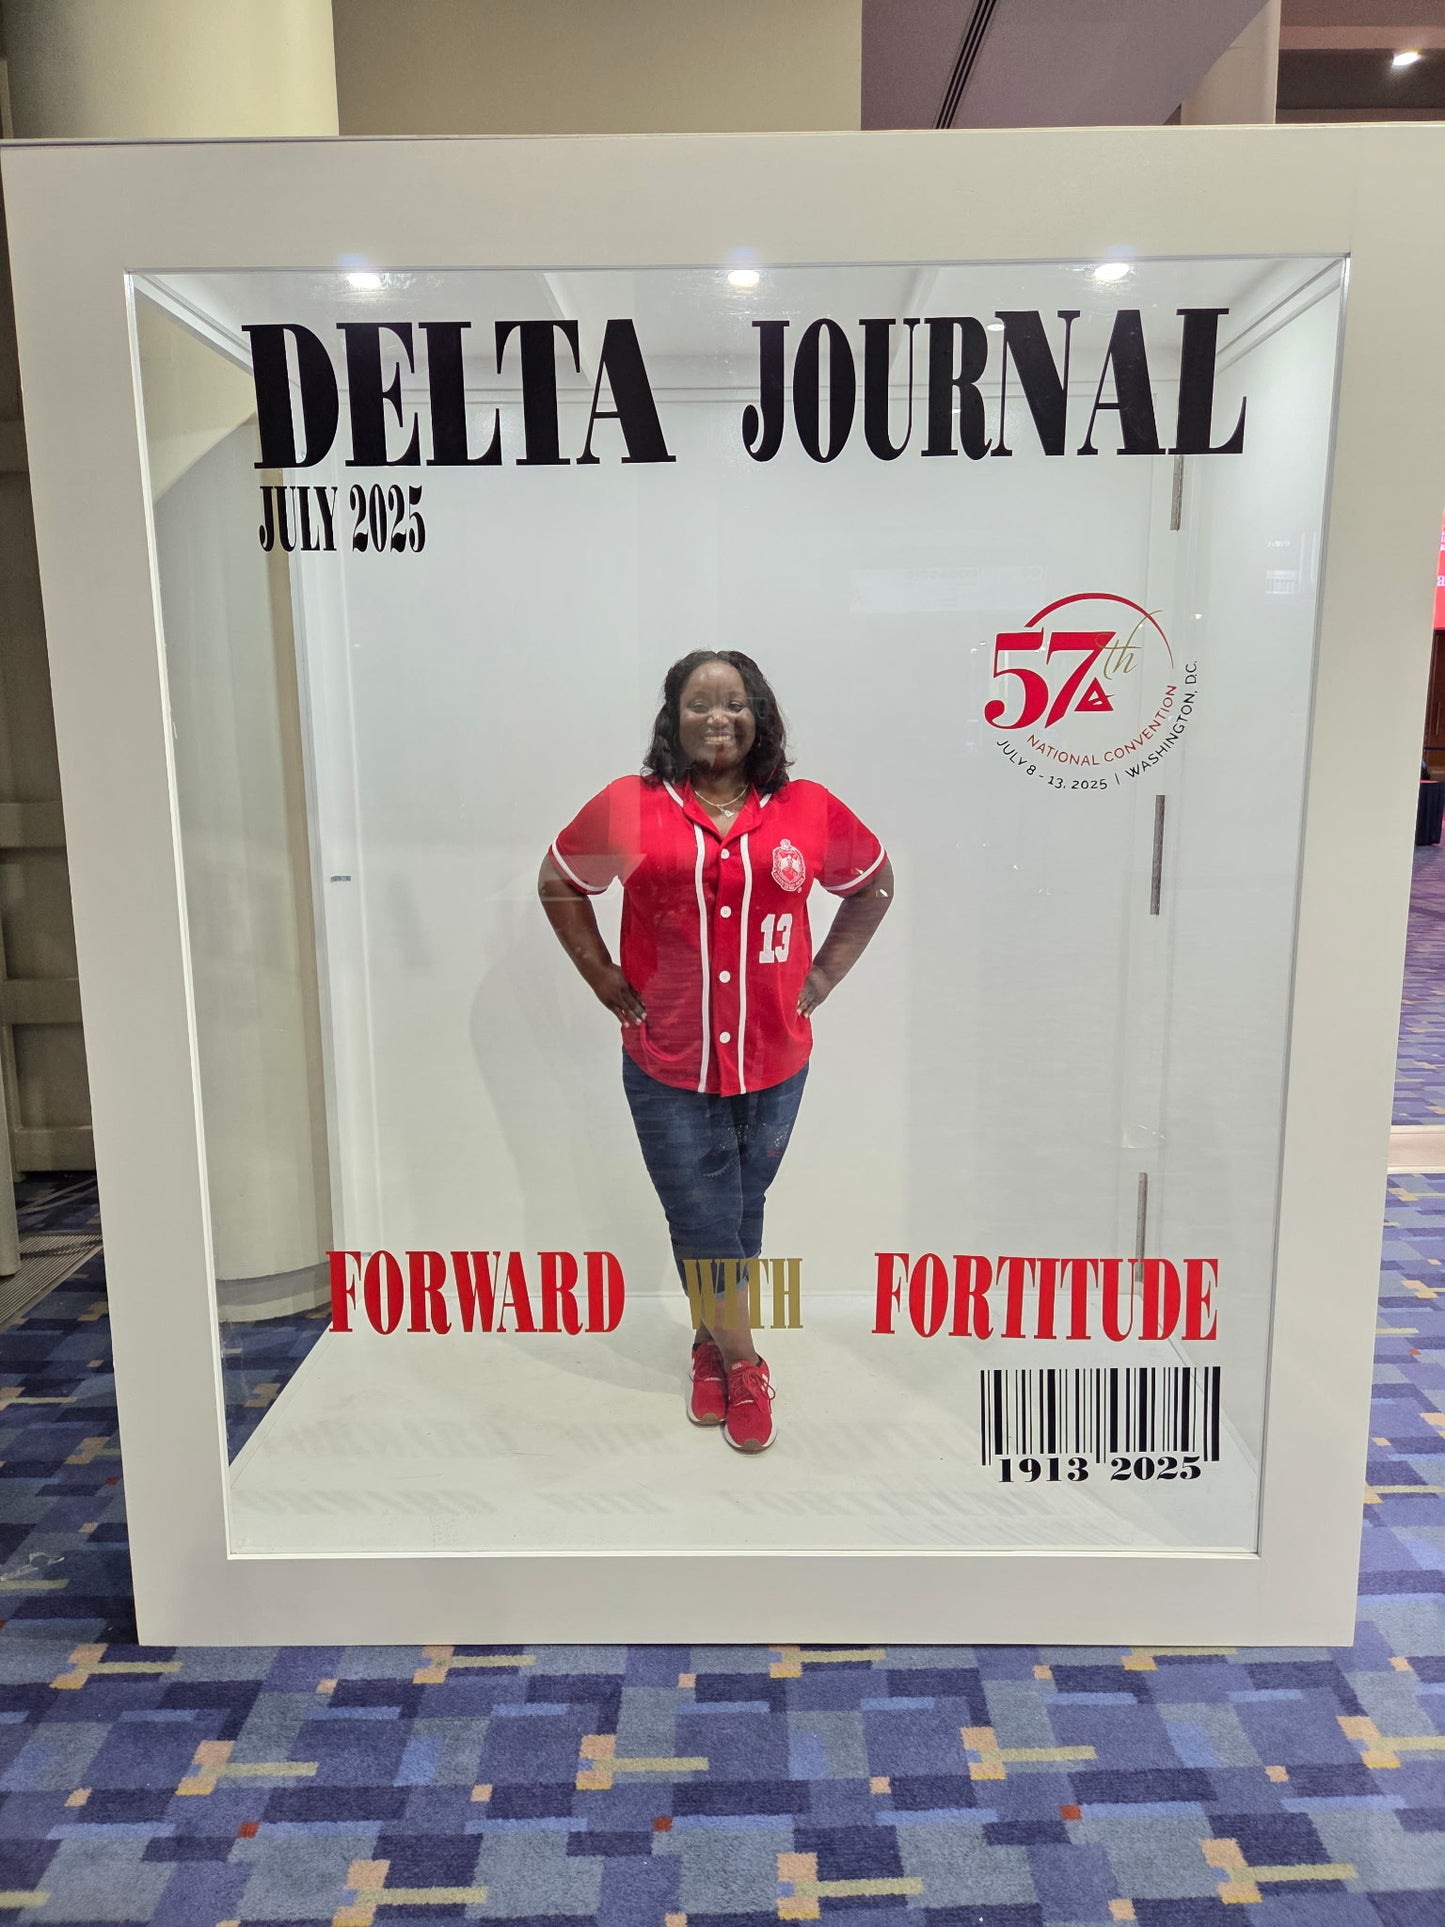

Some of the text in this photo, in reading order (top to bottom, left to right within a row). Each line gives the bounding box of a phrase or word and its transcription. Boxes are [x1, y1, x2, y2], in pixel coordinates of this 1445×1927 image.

[241, 307, 1248, 469] DELTA JOURNAL
[258, 483, 426, 553] JULY 2025
[996, 740, 1028, 766] JULY
[1026, 764, 1037, 776] 8
[1071, 778, 1108, 790] 2025
[1184, 660, 1198, 685] D.C.
[1026, 684, 1177, 767] NATIONAL CONVENTION
[758, 913, 793, 964] 13
[325, 1249, 1219, 1343] FORWARD WITH FORTITUDE
[997, 1455, 1202, 1483] 1913 2025
